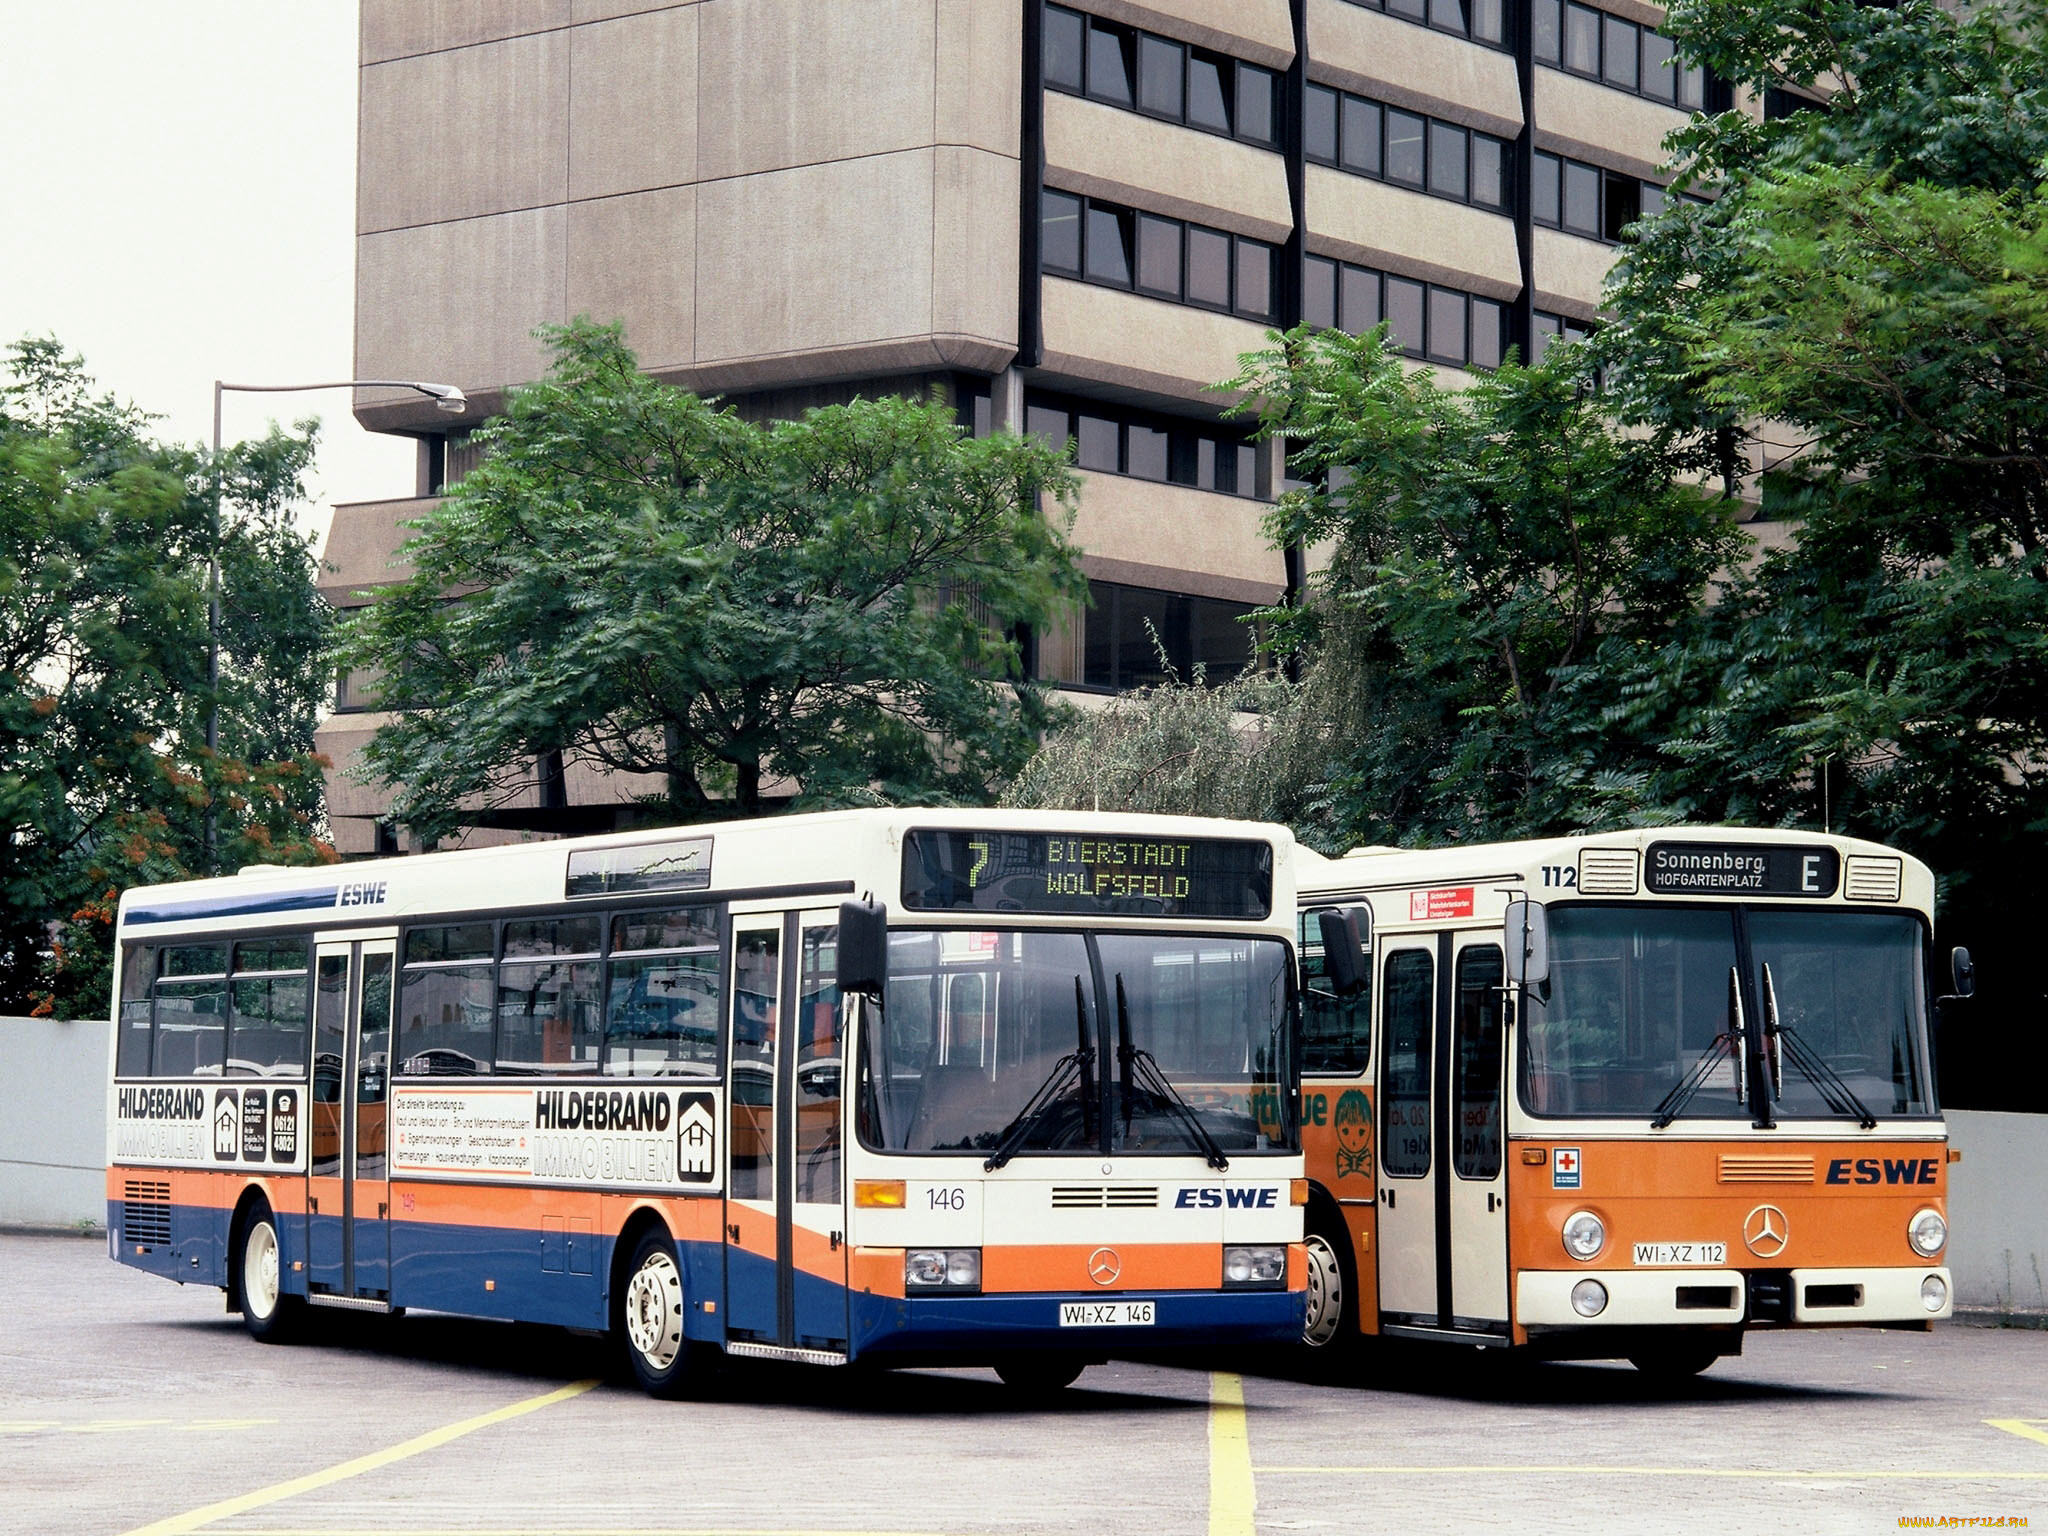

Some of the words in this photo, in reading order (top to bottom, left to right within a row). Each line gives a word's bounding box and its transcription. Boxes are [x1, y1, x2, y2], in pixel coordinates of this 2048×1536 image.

[968, 842, 988, 888] 7
[1048, 841, 1191, 866] BIERSTADT
[1047, 873, 1189, 898] WOLFSFELD
[1541, 866, 1577, 887] 112
[1655, 873, 1763, 888] HOFGARTENPLATZ
[1802, 855, 1821, 891] E
[340, 881, 388, 906] ESWE
[118, 1088, 204, 1120] HILDEBRAND
[535, 1091, 671, 1132] HILDEBRAND
[274, 1115, 295, 1131] 06121
[116, 1123, 205, 1159] IMMOBILIEN
[533, 1135, 674, 1182] IMMOBILIEN
[1825, 1159, 1940, 1185] ESWE
[926, 1188, 965, 1210] 146
[1174, 1188, 1280, 1209] ESWE
[1701, 1245, 1723, 1262] 112
[1126, 1304, 1152, 1322] 146
